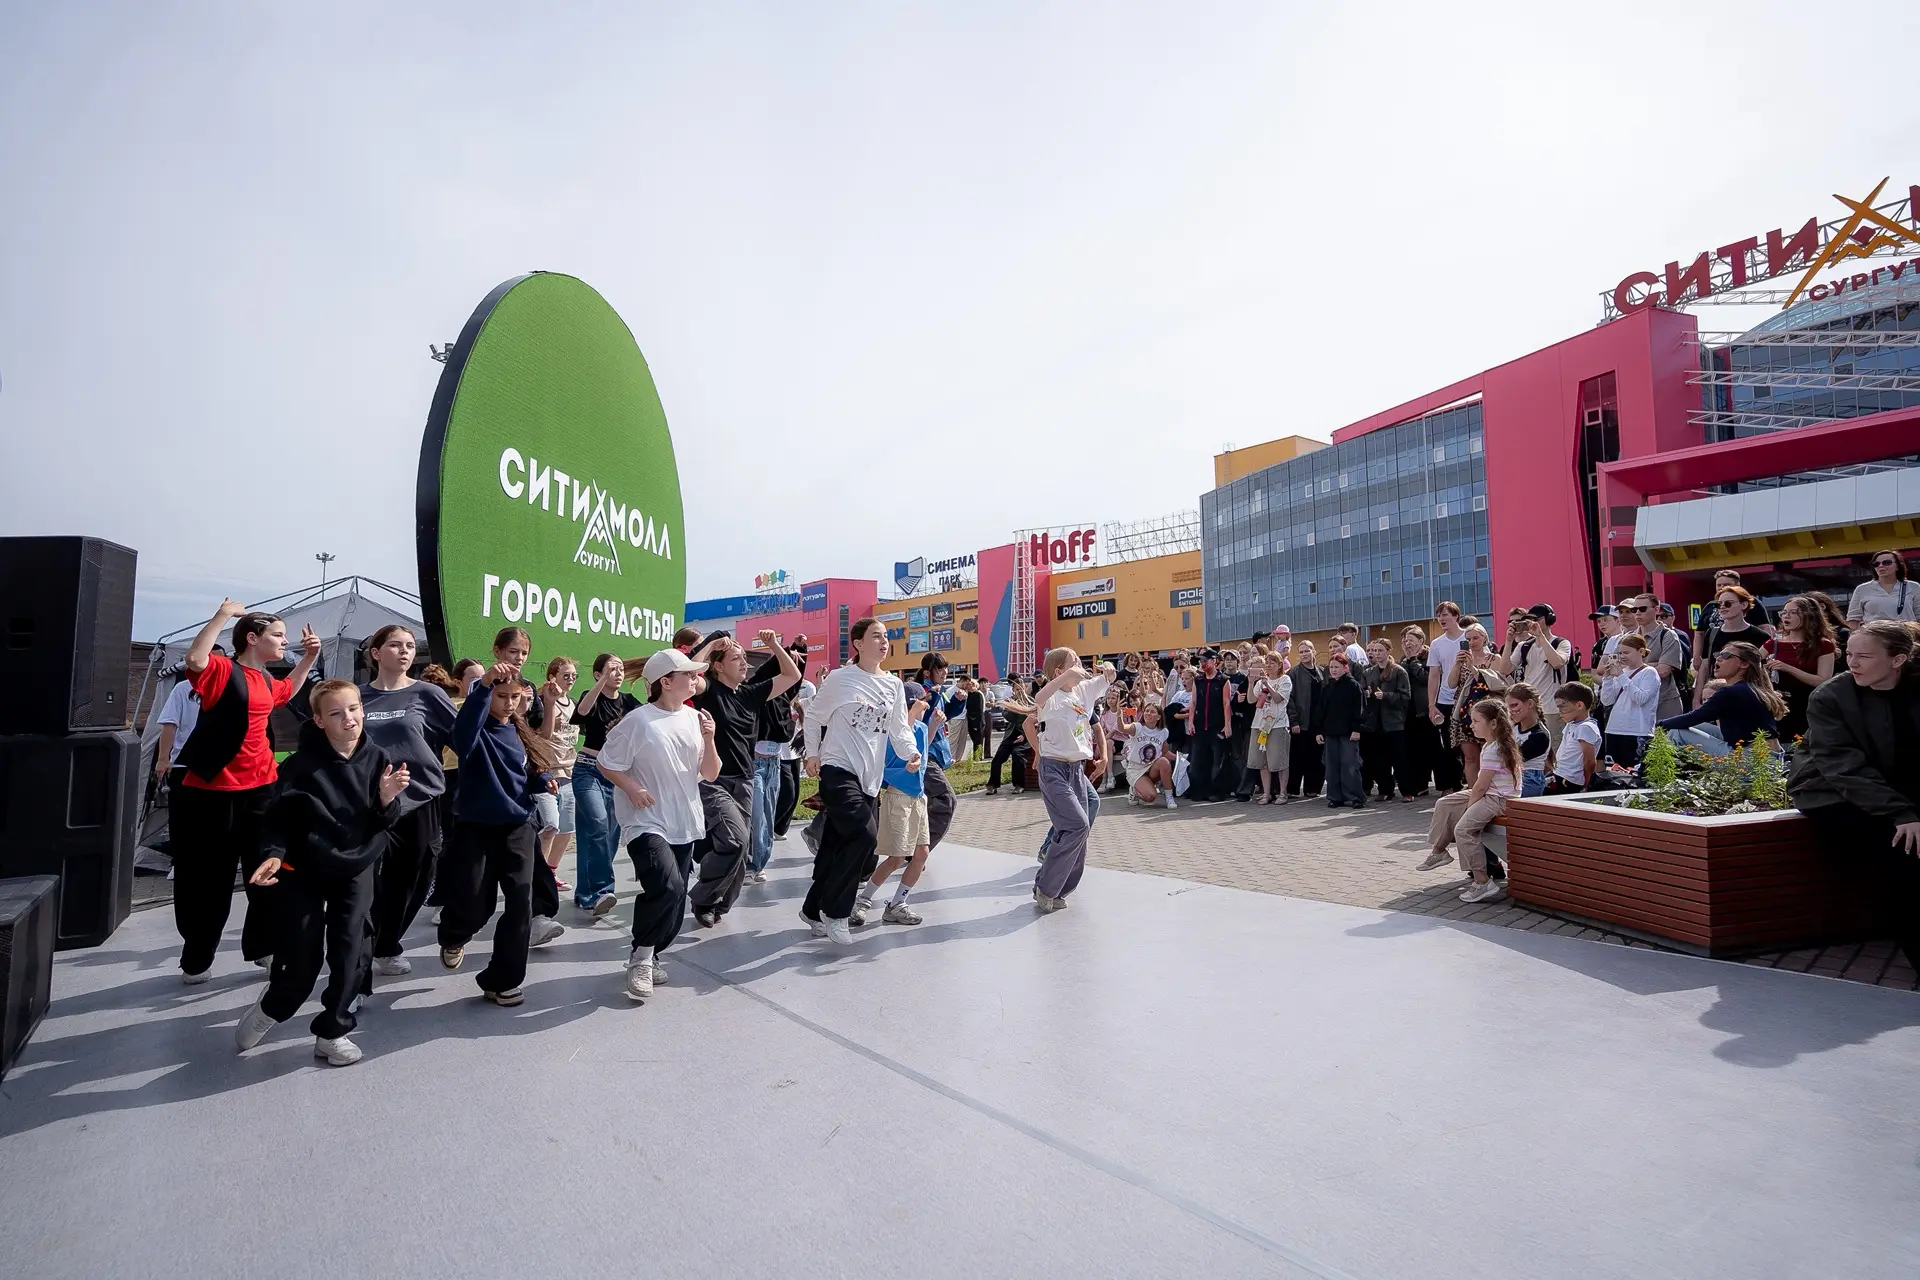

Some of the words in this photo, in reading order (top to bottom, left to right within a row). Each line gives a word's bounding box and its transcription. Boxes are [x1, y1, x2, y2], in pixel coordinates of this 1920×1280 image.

[1614, 217, 1819, 314] СИТИ
[499, 448, 590, 523] СИТИ
[610, 496, 671, 560] МОЛЛ
[580, 550, 616, 574] СУРГУТ
[1031, 529, 1096, 566] Hoff
[928, 554, 975, 574] СИНЕМА
[939, 574, 960, 586] ПАРК
[482, 574, 581, 634] ГОРОД
[588, 598, 675, 643] СЧАСТЬЯ!
[1063, 605, 1083, 617] РИВ
[1085, 602, 1107, 614] ГОШ
